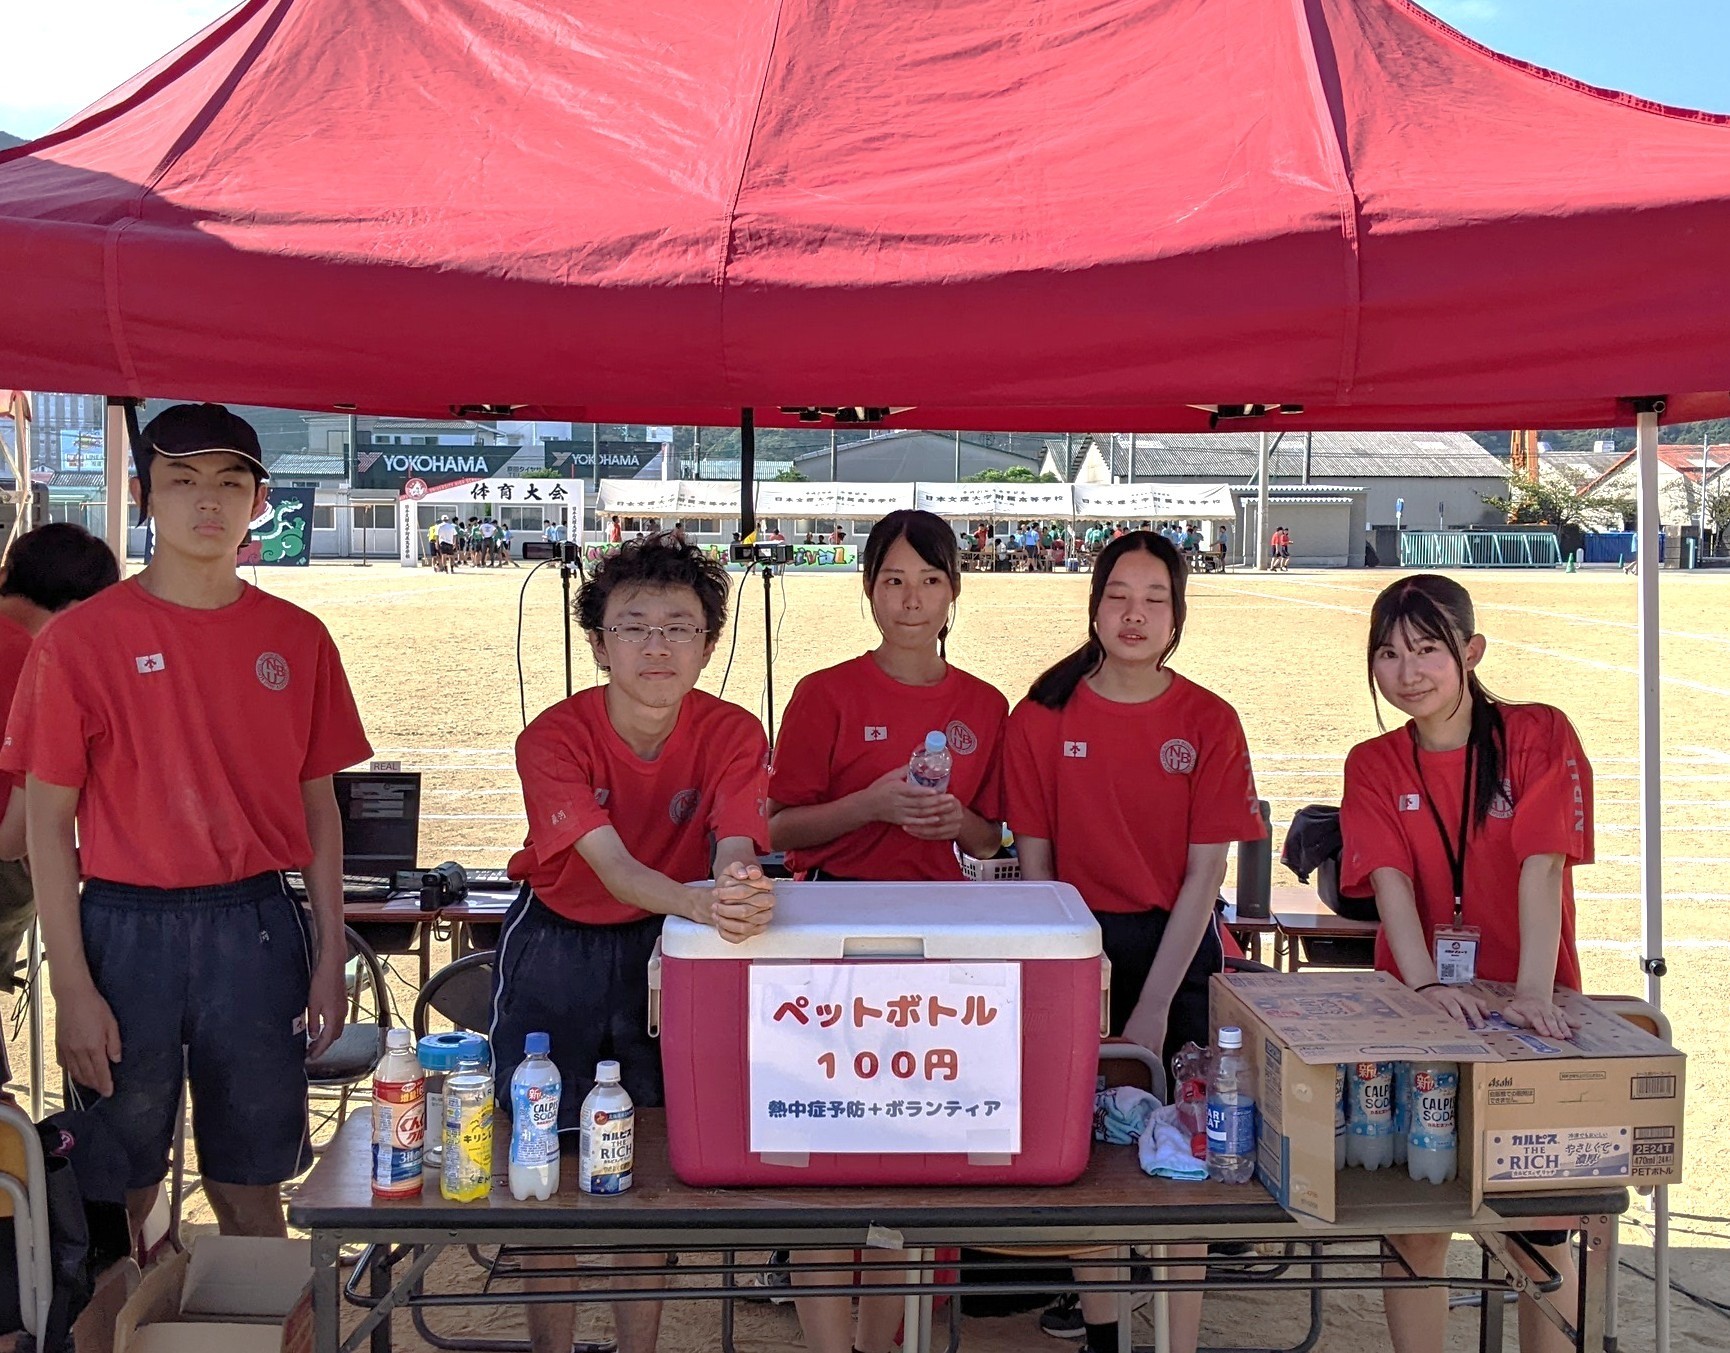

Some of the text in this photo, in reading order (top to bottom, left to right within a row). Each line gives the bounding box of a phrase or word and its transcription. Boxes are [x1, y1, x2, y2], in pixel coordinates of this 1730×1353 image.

[383, 455, 489, 472] YOKOHAMA
[470, 482, 568, 501] 体育大会
[373, 762, 398, 771] REAL
[773, 993, 998, 1028] ペットボトル
[817, 1048, 959, 1082] 100円
[1488, 1076, 1513, 1087] Asahi
[768, 1099, 1002, 1118] 熱中症予防＋ボランティア
[533, 1110, 557, 1122] SODA
[602, 1128, 632, 1141] カルピス
[1511, 1134, 1558, 1146] カルピス
[611, 1139, 627, 1147] THE
[1565, 1142, 1612, 1156] やさしくて
[1635, 1144, 1672, 1154] 2E24T
[600, 1144, 632, 1159] RICH
[1523, 1146, 1546, 1154] THE
[1510, 1154, 1560, 1170] RICH
[1634, 1156, 1656, 1165] 470ml
[1632, 1167, 1674, 1176] PETボトル
